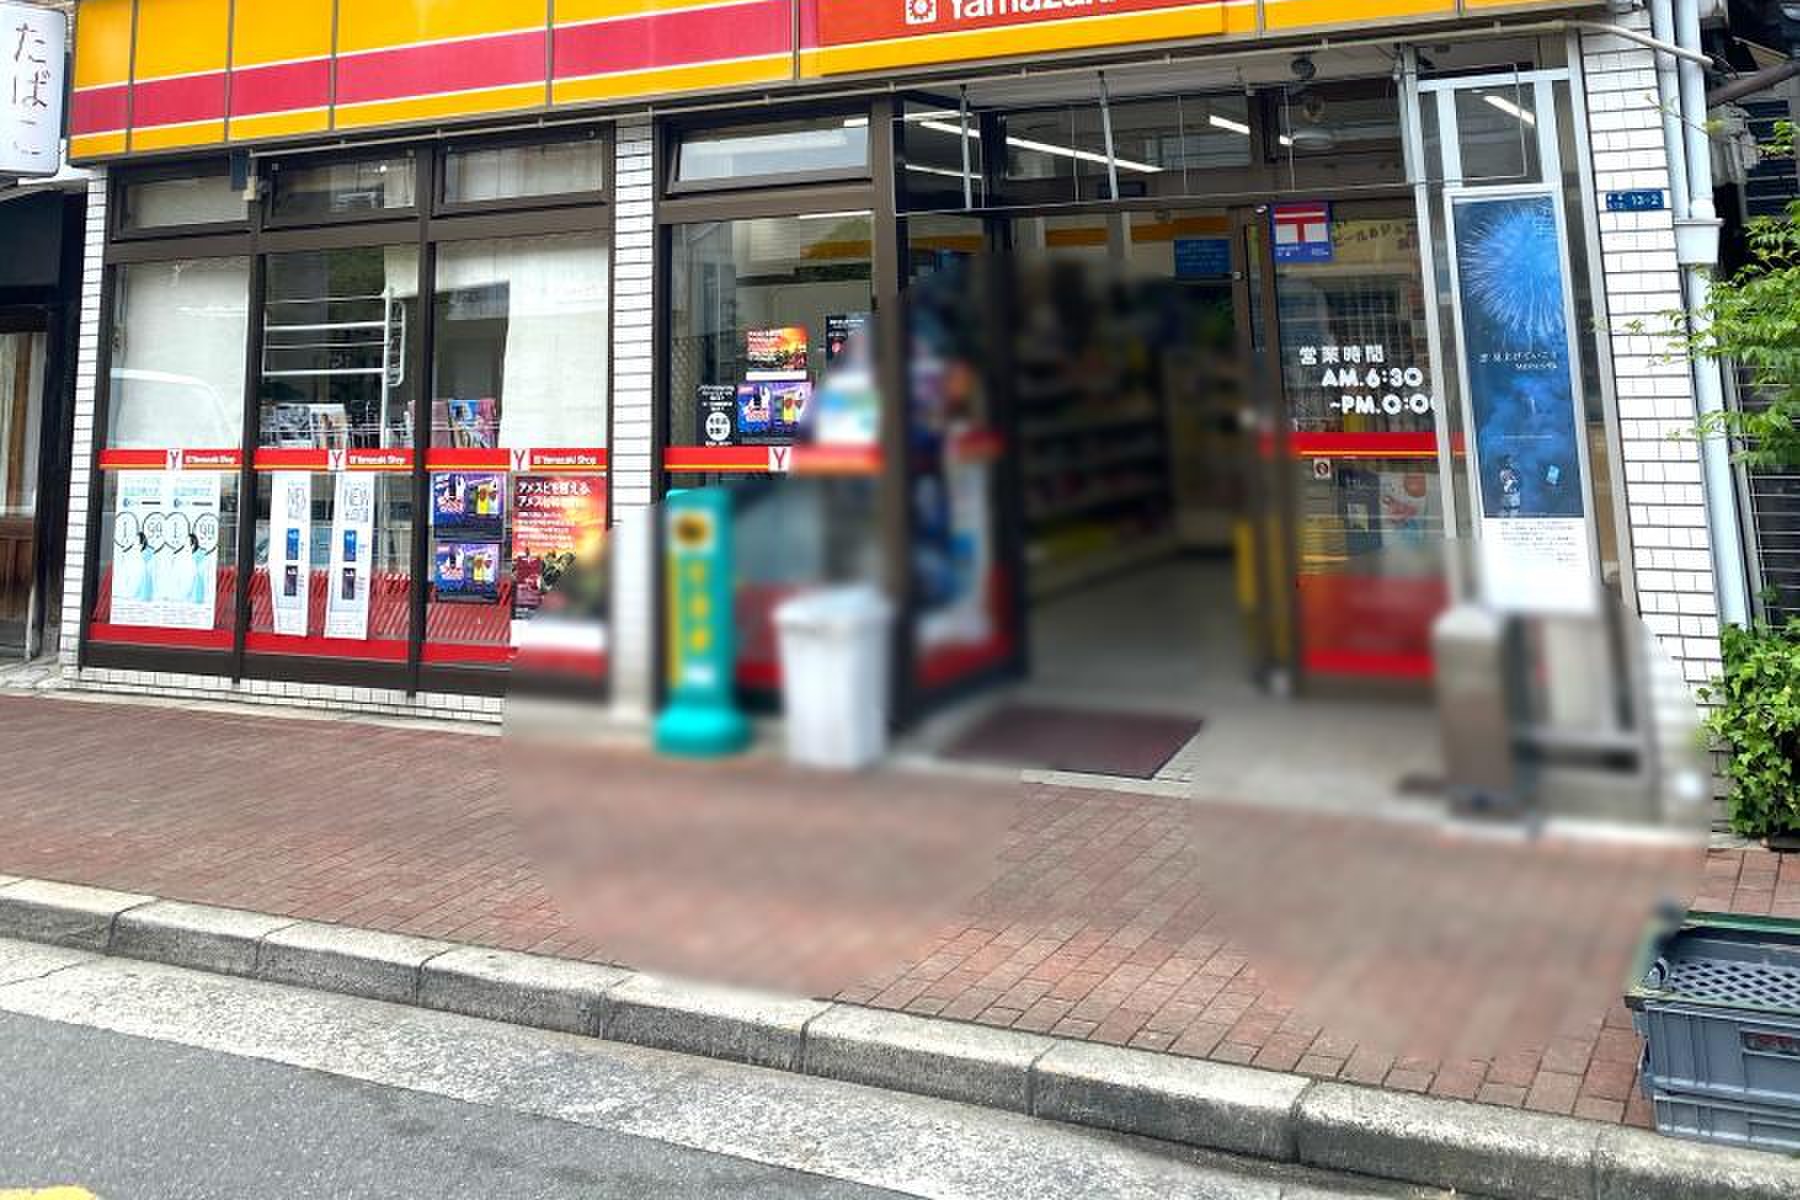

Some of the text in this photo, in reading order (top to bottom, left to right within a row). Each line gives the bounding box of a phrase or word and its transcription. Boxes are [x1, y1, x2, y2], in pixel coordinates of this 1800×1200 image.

[1299, 344, 1384, 365] 営業時間
[1321, 367, 1424, 389] AM.6:30
